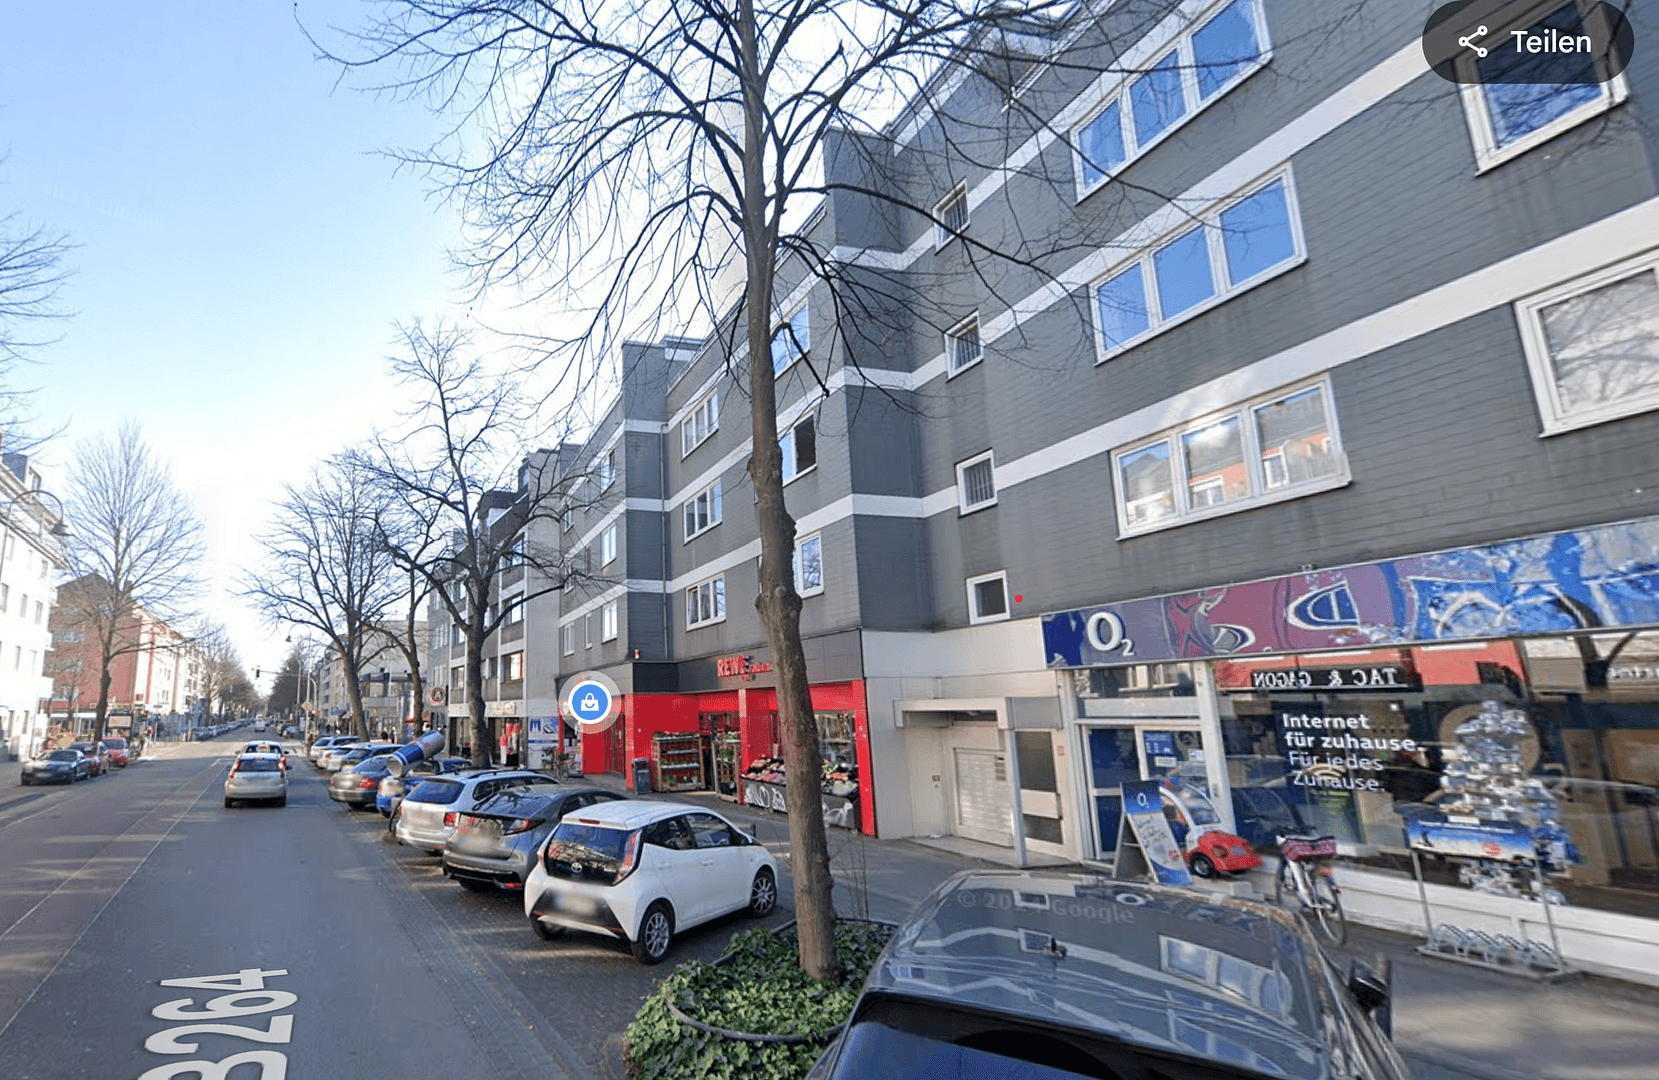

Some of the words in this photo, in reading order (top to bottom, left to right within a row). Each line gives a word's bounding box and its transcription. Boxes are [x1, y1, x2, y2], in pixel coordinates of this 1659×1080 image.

[1282, 713, 1371, 729] Internet
[1285, 732, 1316, 747] für
[1321, 733, 1427, 752] zuhause.
[1288, 751, 1319, 766] Für
[1325, 753, 1384, 771] jedes
